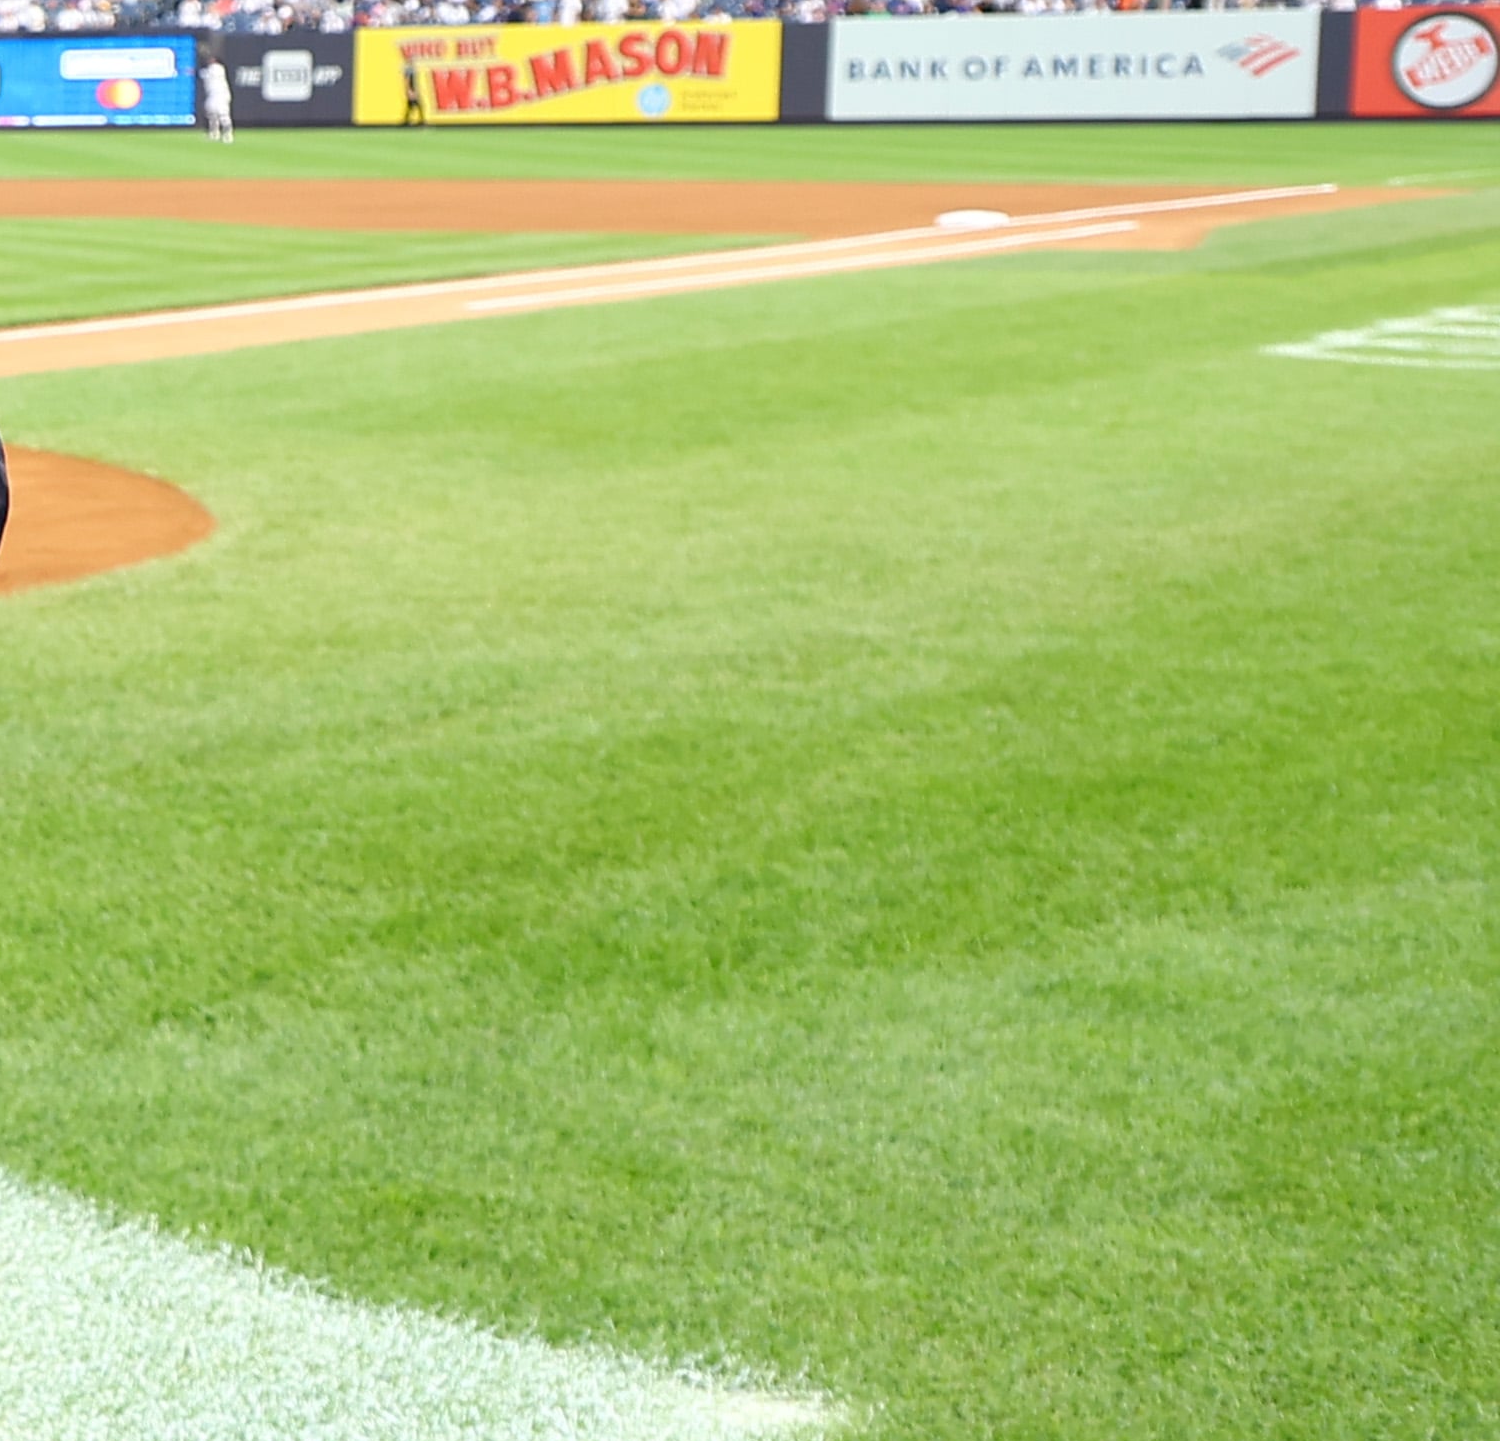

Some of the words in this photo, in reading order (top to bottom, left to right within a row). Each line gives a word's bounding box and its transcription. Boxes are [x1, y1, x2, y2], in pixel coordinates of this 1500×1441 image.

[847, 59, 949, 81] BANK
[964, 55, 1010, 80] OF
[1022, 51, 1206, 78] AMERICA
